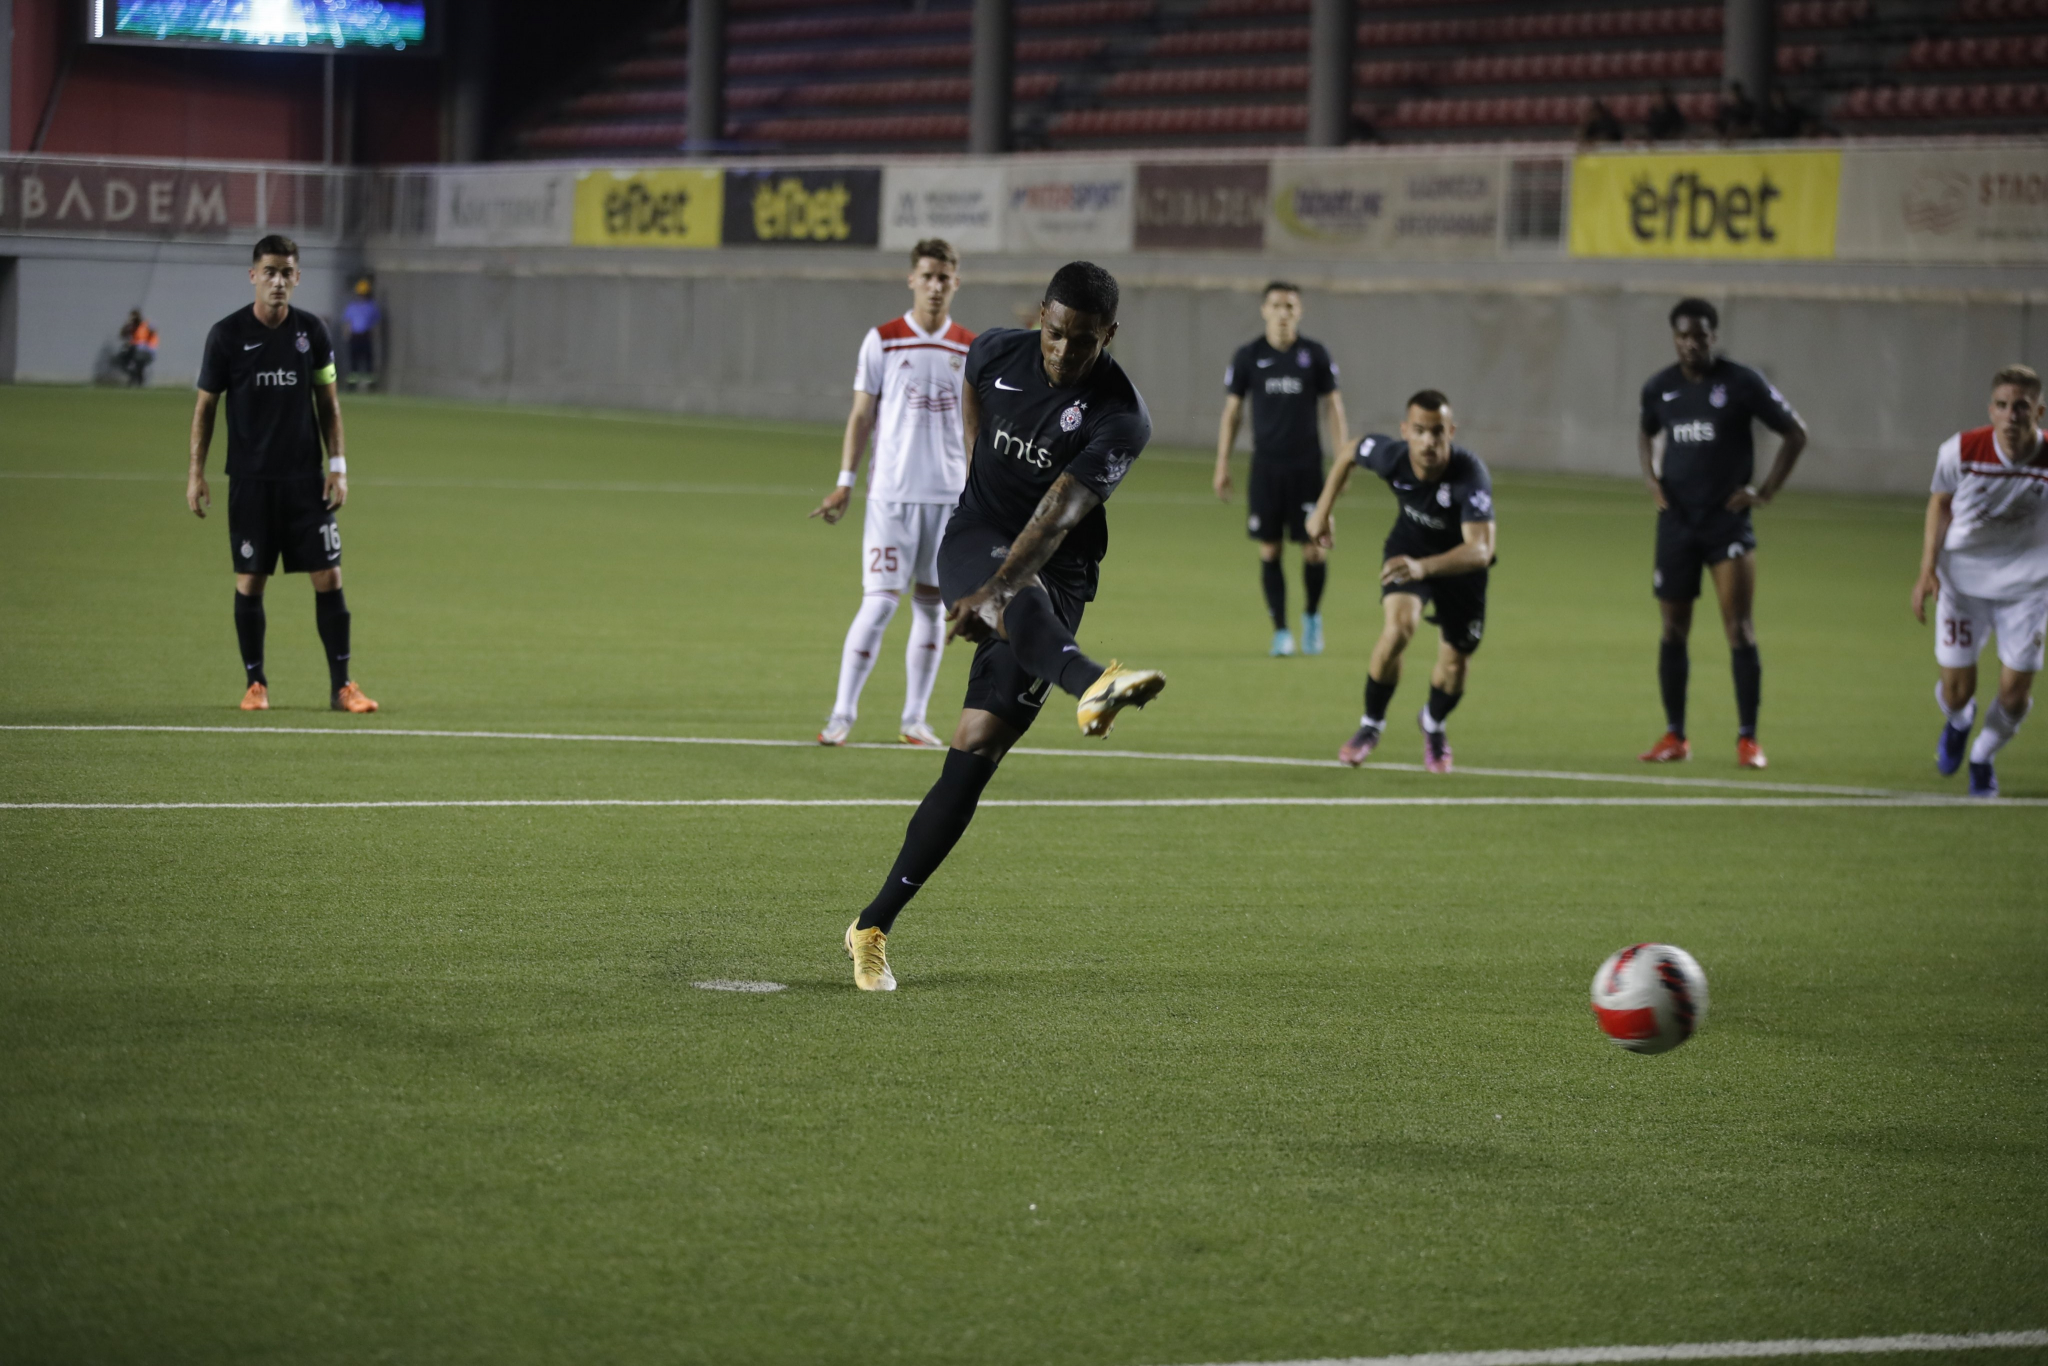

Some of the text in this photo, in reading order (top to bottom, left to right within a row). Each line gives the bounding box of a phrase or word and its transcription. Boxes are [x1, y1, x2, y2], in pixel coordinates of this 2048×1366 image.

[602, 180, 690, 237] efbet
[752, 178, 853, 241] efbet
[1629, 171, 1781, 243] efbet
[256, 367, 298, 387] mts
[1265, 374, 1303, 395] mts
[1673, 419, 1716, 444] mts
[993, 428, 1053, 469] mts
[1403, 504, 1446, 531] mts
[319, 522, 341, 552] 16
[869, 546, 898, 573] 25
[1943, 619, 1972, 648] 35
